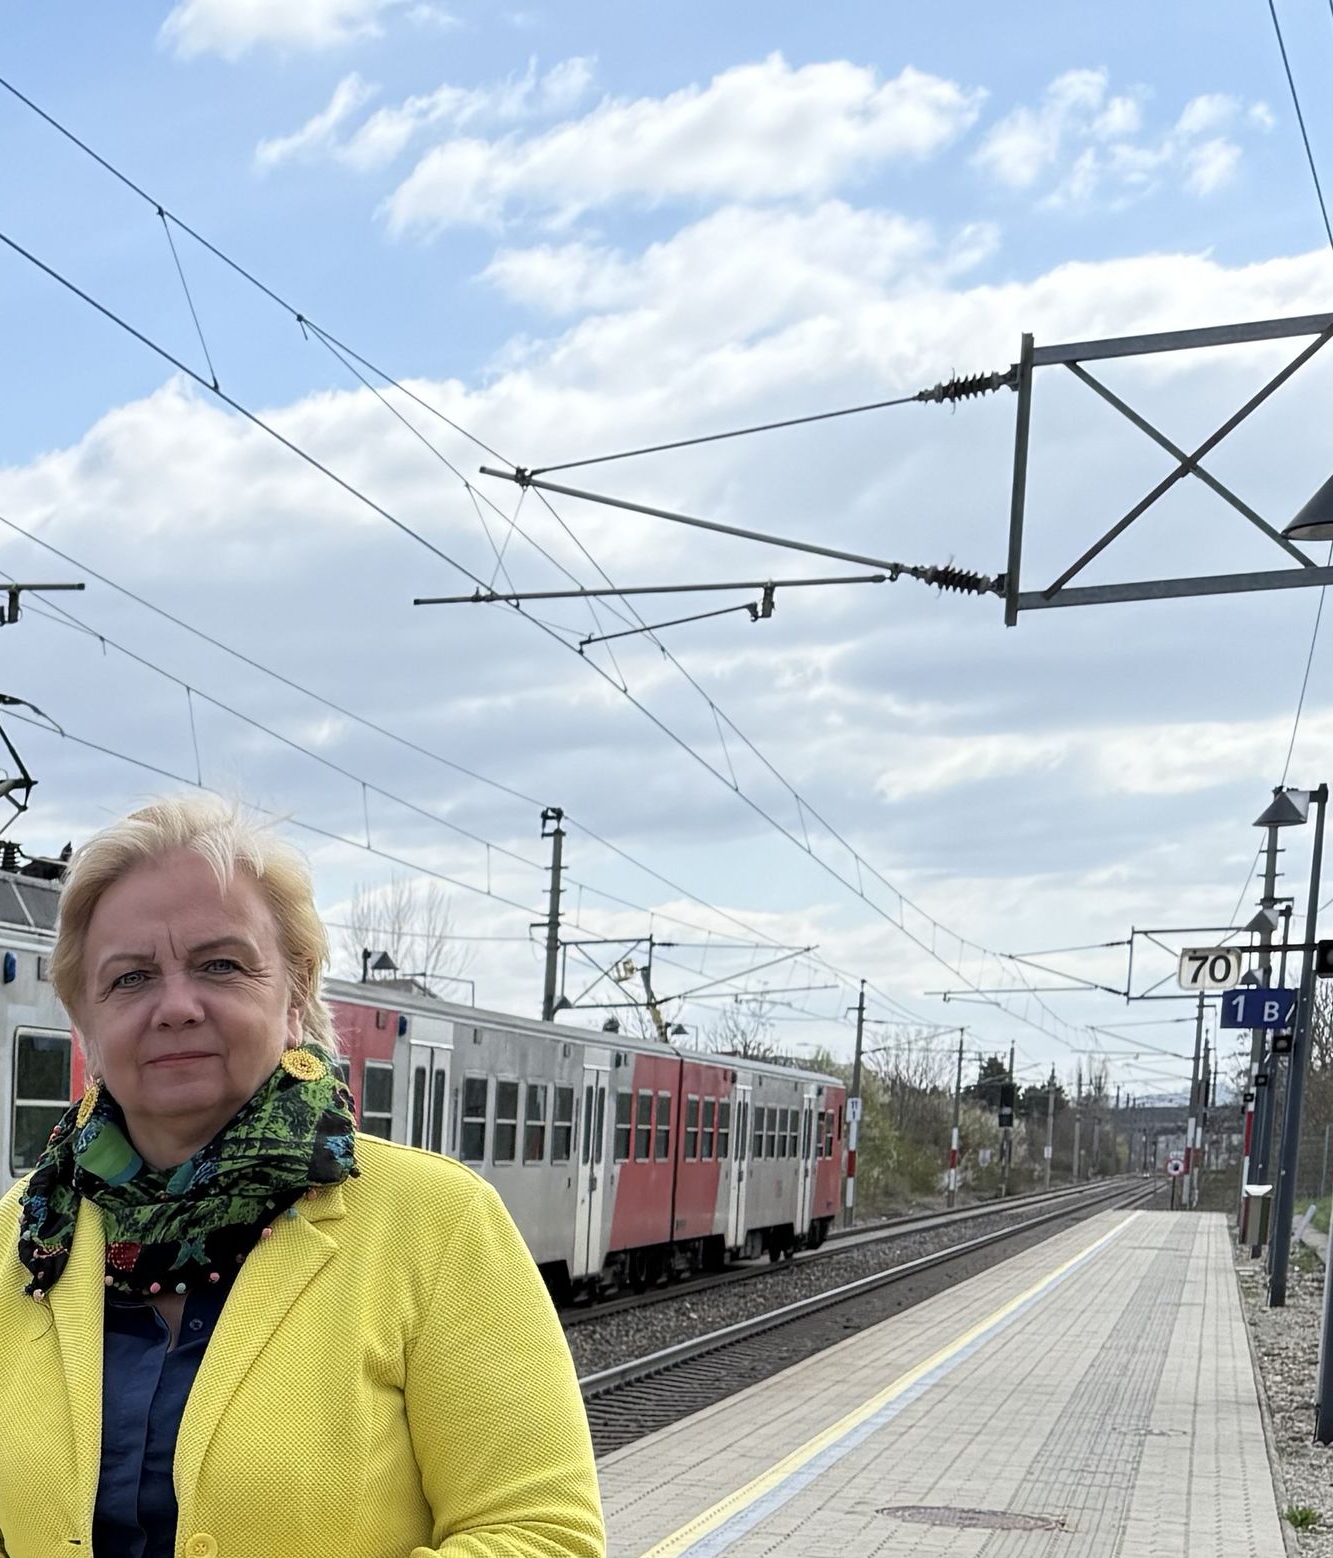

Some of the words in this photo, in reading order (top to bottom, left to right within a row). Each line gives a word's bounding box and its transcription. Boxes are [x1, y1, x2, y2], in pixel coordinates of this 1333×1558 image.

[1188, 954, 1232, 984] 70
[1232, 994, 1245, 1022] 1
[1263, 1001, 1279, 1022] B
